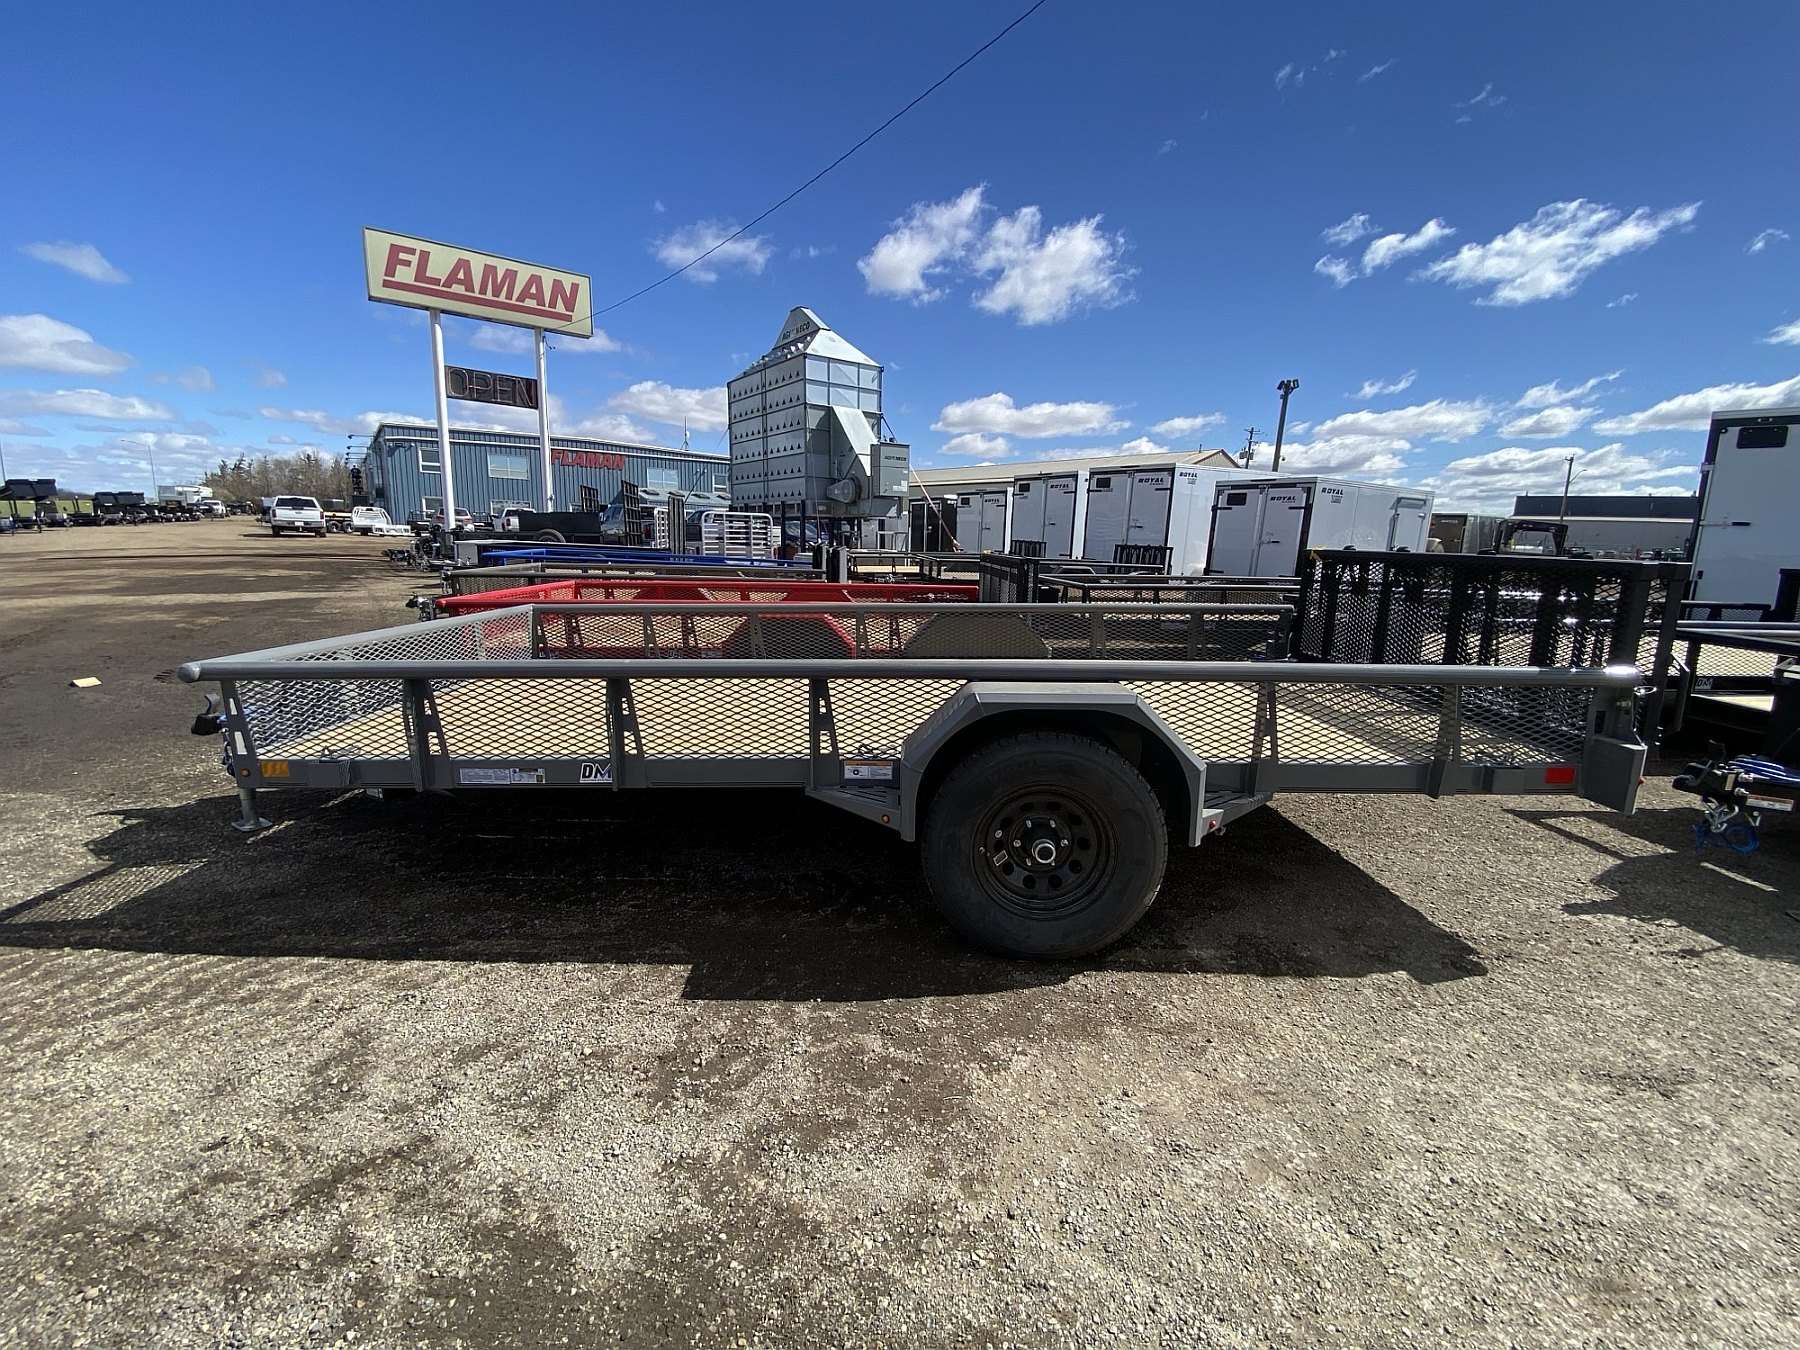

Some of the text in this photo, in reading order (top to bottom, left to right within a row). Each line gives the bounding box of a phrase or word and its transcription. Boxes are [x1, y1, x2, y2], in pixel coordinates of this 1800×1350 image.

[384, 243, 580, 313] FLAMAN
[447, 367, 535, 407] OPEN
[551, 448, 626, 471] FLAMAN
[1321, 487, 1344, 496] ROYAL
[581, 762, 612, 779] DM
